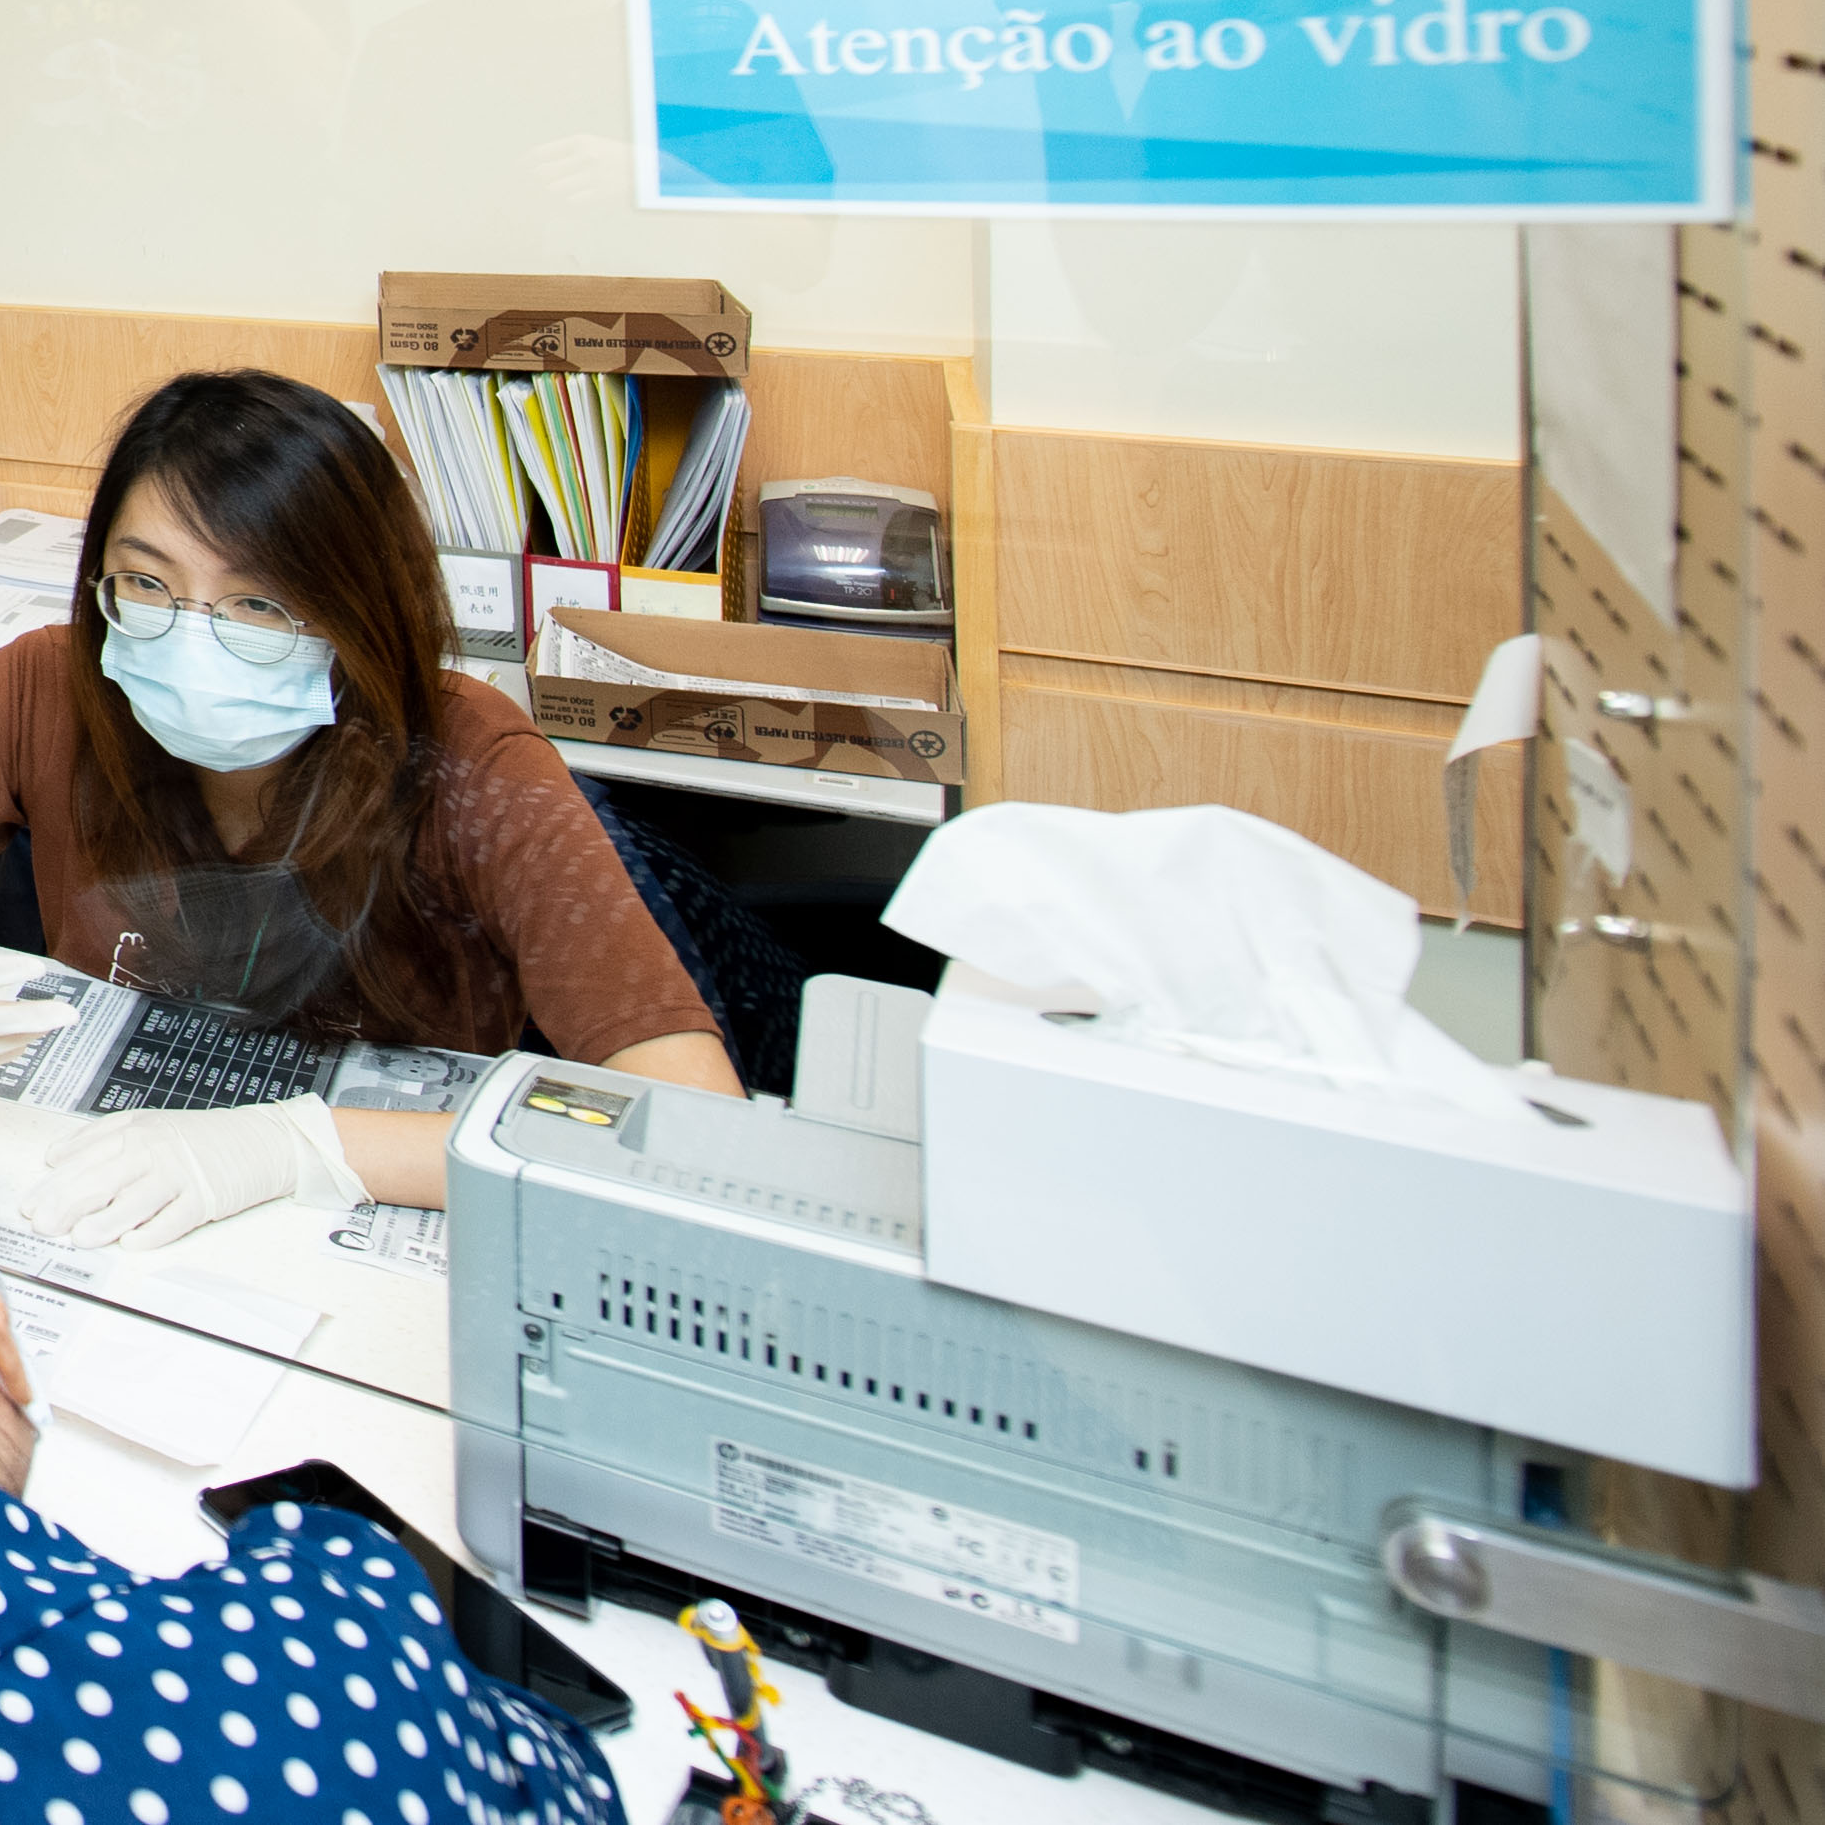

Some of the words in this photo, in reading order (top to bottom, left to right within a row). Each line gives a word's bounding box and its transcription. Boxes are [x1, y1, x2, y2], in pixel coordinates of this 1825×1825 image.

[732, 9, 1112, 90] Atenção
[1145, 17, 1265, 72] ao
[389, 339, 420, 351] Gsm
[424, 340, 439, 352] 80
[574, 336, 604, 348] PAPER
[605, 337, 652, 349] RECYCLED
[755, 725, 790, 741] PAPER
